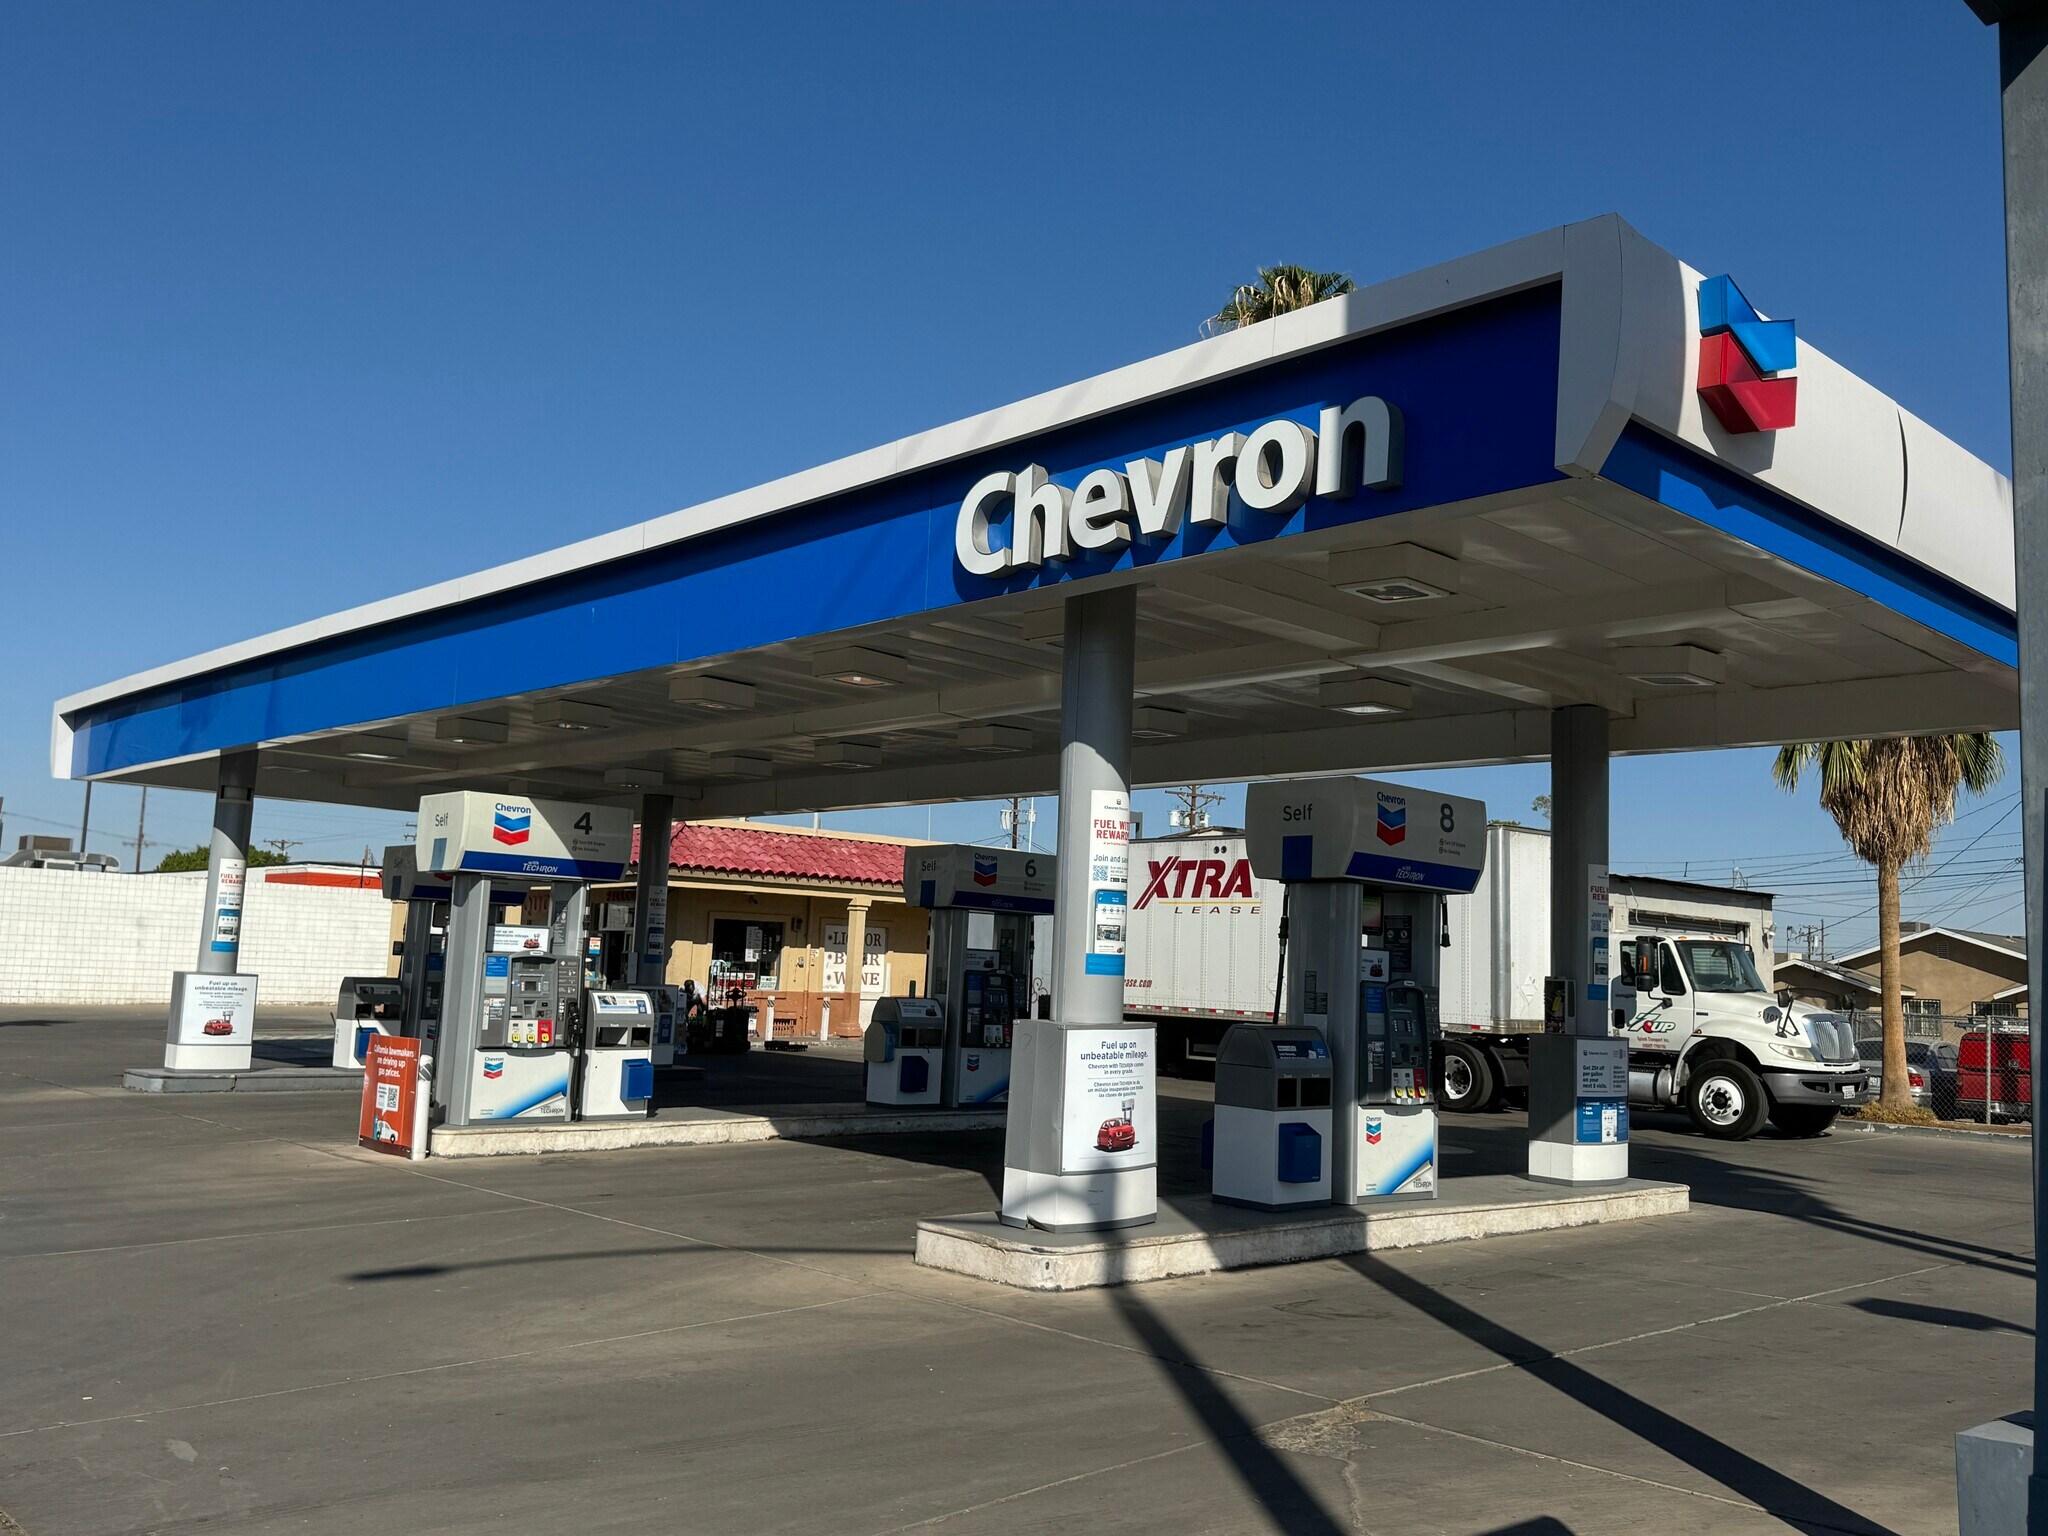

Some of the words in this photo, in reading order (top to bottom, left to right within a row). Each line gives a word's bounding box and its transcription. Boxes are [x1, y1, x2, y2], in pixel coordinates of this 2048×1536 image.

[956, 395, 1404, 578] Chevron
[1376, 791, 1406, 806] Chevron
[494, 802, 532, 815] Chevron
[1283, 803, 1313, 821] Self
[435, 812, 449, 828] Self
[573, 811, 593, 835] 4
[1093, 818, 1117, 829] FUEL
[1439, 803, 1455, 833] 8
[974, 852, 998, 862] Chevron
[1093, 854, 1109, 862] Join
[1110, 855, 1121, 863] and
[522, 863, 558, 873] TECHRON
[921, 860, 937, 871] Self
[1024, 858, 1037, 878] 6
[1395, 868, 1425, 881] TECHRON
[1133, 856, 1253, 909] XTRA
[1174, 906, 1261, 914] LEASE
[833, 931, 882, 947] LIOR
[834, 972, 880, 986] WNE
[388, 1046, 414, 1058] lawmakers
[1101, 1041, 1117, 1049] Fuel
[1118, 1041, 1128, 1050] up
[1128, 1041, 1137, 1049] on
[1080, 1051, 1124, 1060] unbeatable
[1125, 1050, 1149, 1059] mileage.
[383, 1057, 397, 1068] driving
[398, 1060, 406, 1069] up
